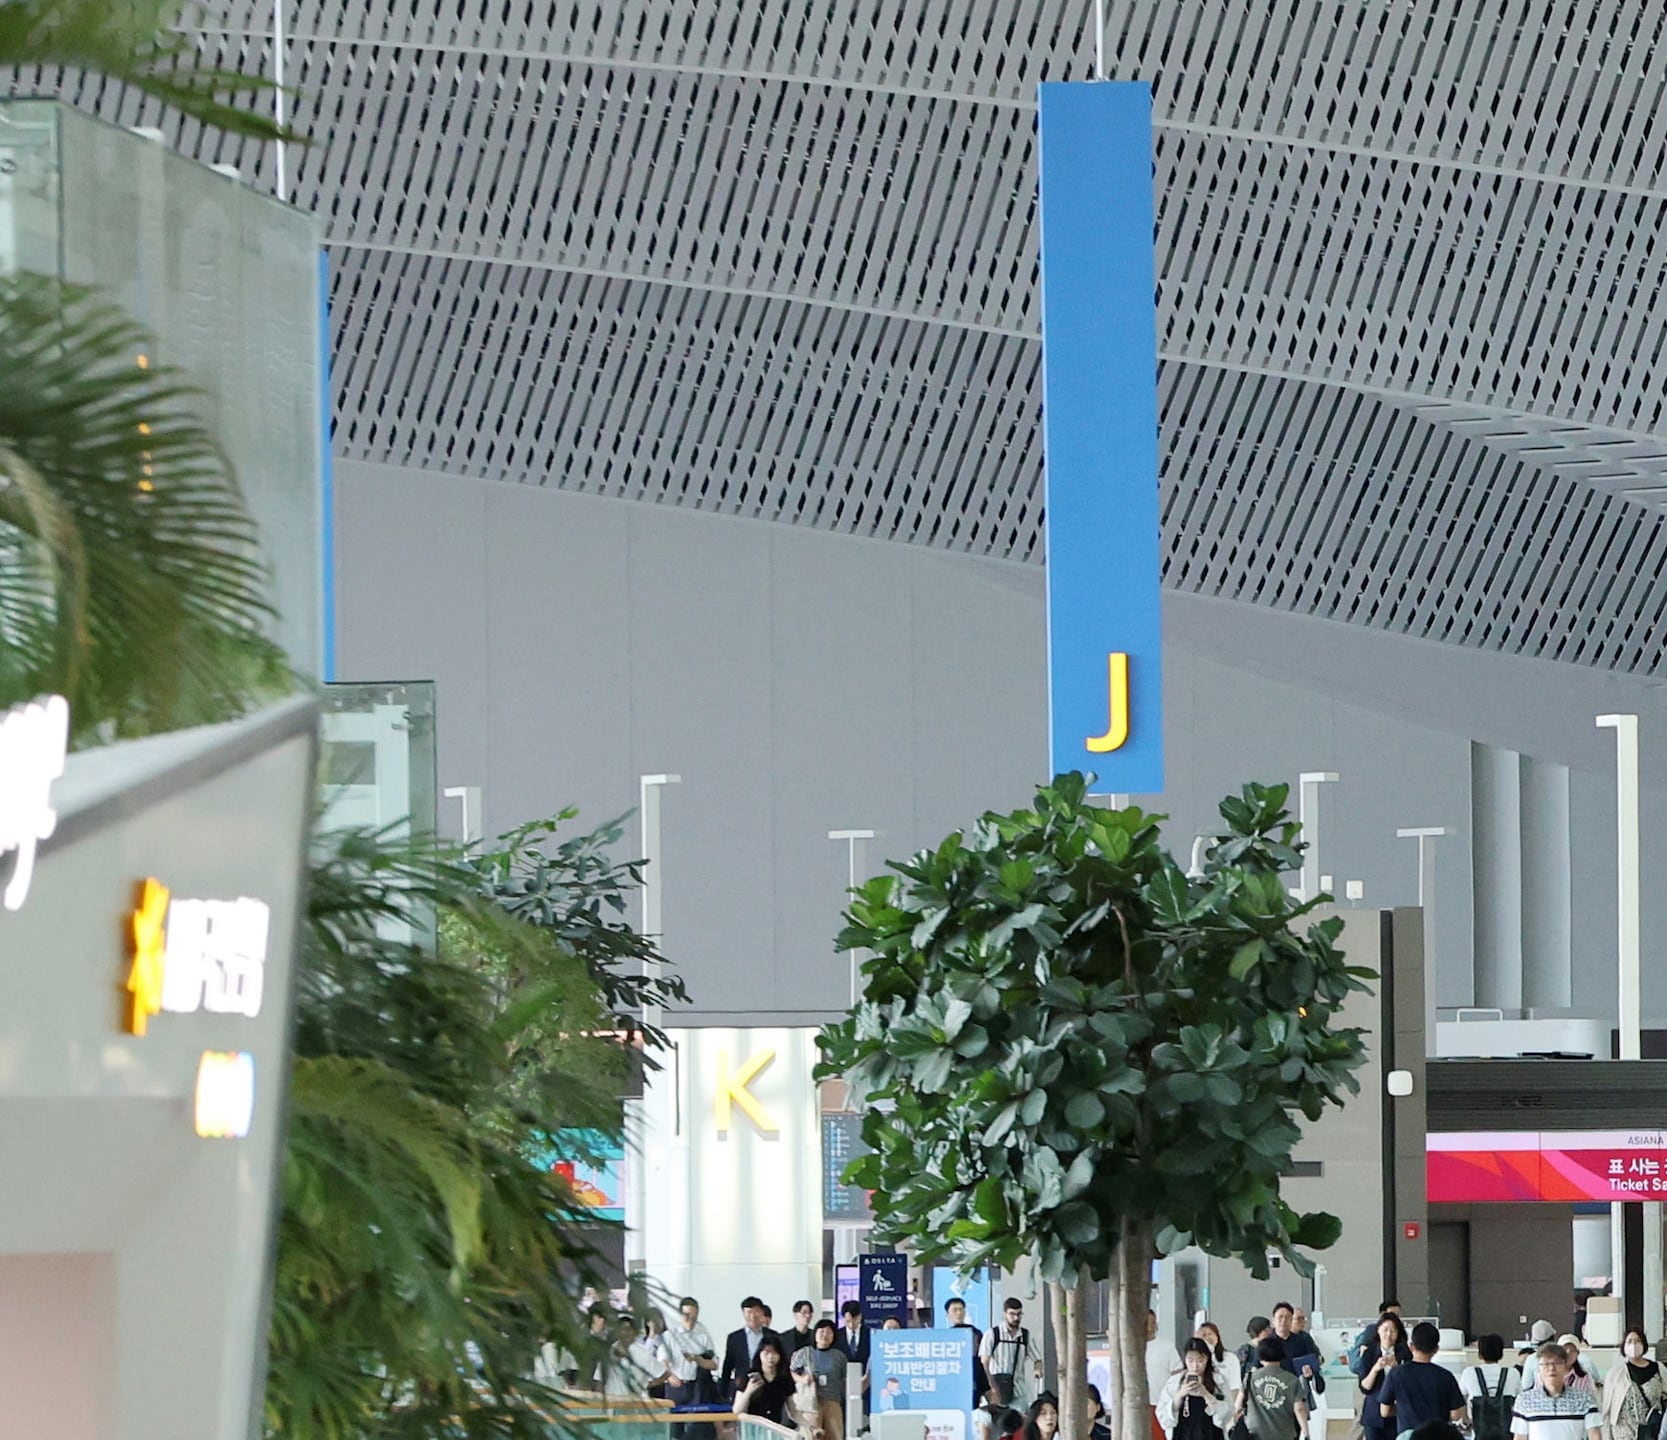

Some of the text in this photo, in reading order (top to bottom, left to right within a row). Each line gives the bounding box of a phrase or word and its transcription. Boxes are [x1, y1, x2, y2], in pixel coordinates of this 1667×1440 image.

[1087, 653, 1129, 752] J
[715, 1050, 779, 1131] K
[1628, 1136, 1664, 1145] ASIANA
[1608, 1159, 1625, 1174] 표
[1629, 1158, 1660, 1175] 사는
[1608, 1178, 1649, 1191] Ticket
[910, 1378, 937, 1392] 안내
